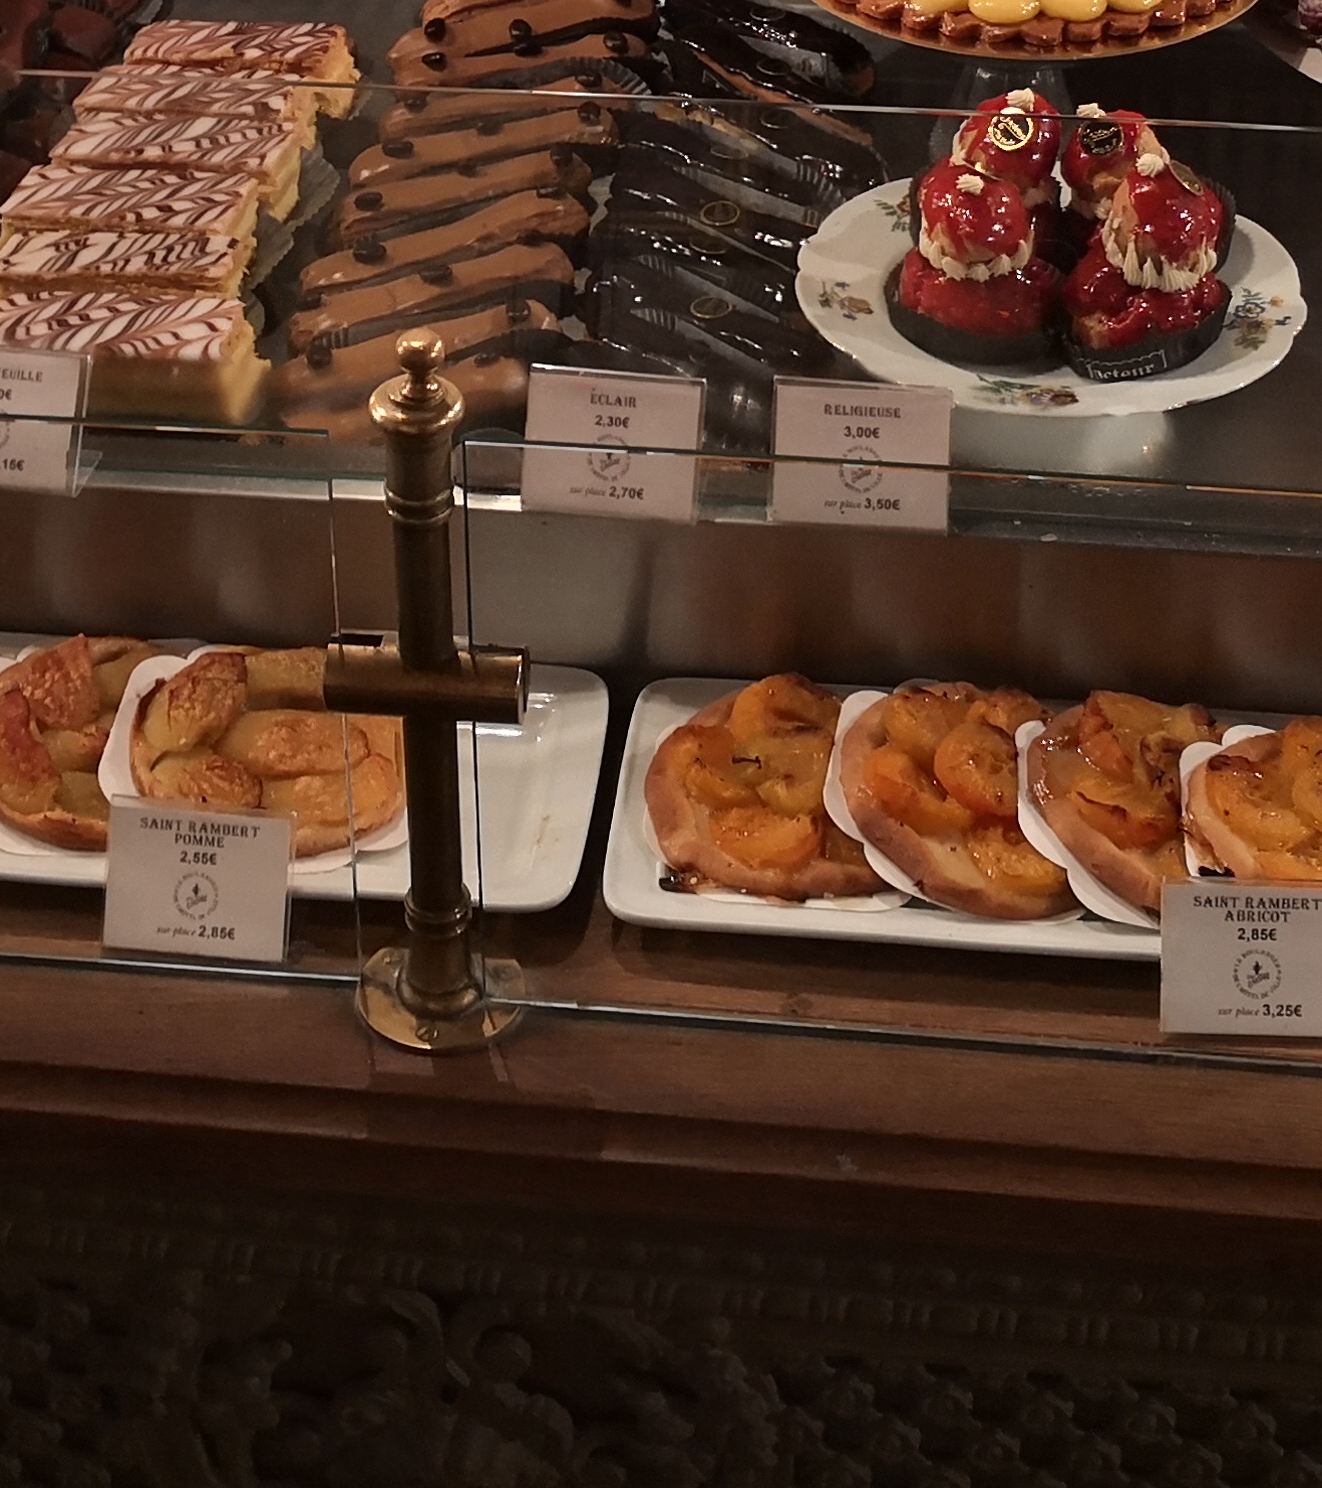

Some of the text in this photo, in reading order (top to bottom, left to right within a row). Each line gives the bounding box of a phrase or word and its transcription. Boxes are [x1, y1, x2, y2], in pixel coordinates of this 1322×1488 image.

[590, 388, 637, 409] ÉCLAIR
[823, 403, 902, 419] RELIGIEUSE
[594, 414, 630, 429] 2,30€
[843, 425, 881, 439] 3,00€
[608, 485, 644, 501] 2,70€
[863, 497, 901, 512] 3,50€
[140, 816, 261, 839] SAINT RAMBERT
[174, 832, 225, 849] POMME
[1193, 895, 1322, 912] SAINT RAMBERT
[1224, 910, 1292, 924] ABRICOT
[1237, 927, 1278, 943] 2,85€
[1262, 1004, 1303, 1019] 3,25€
